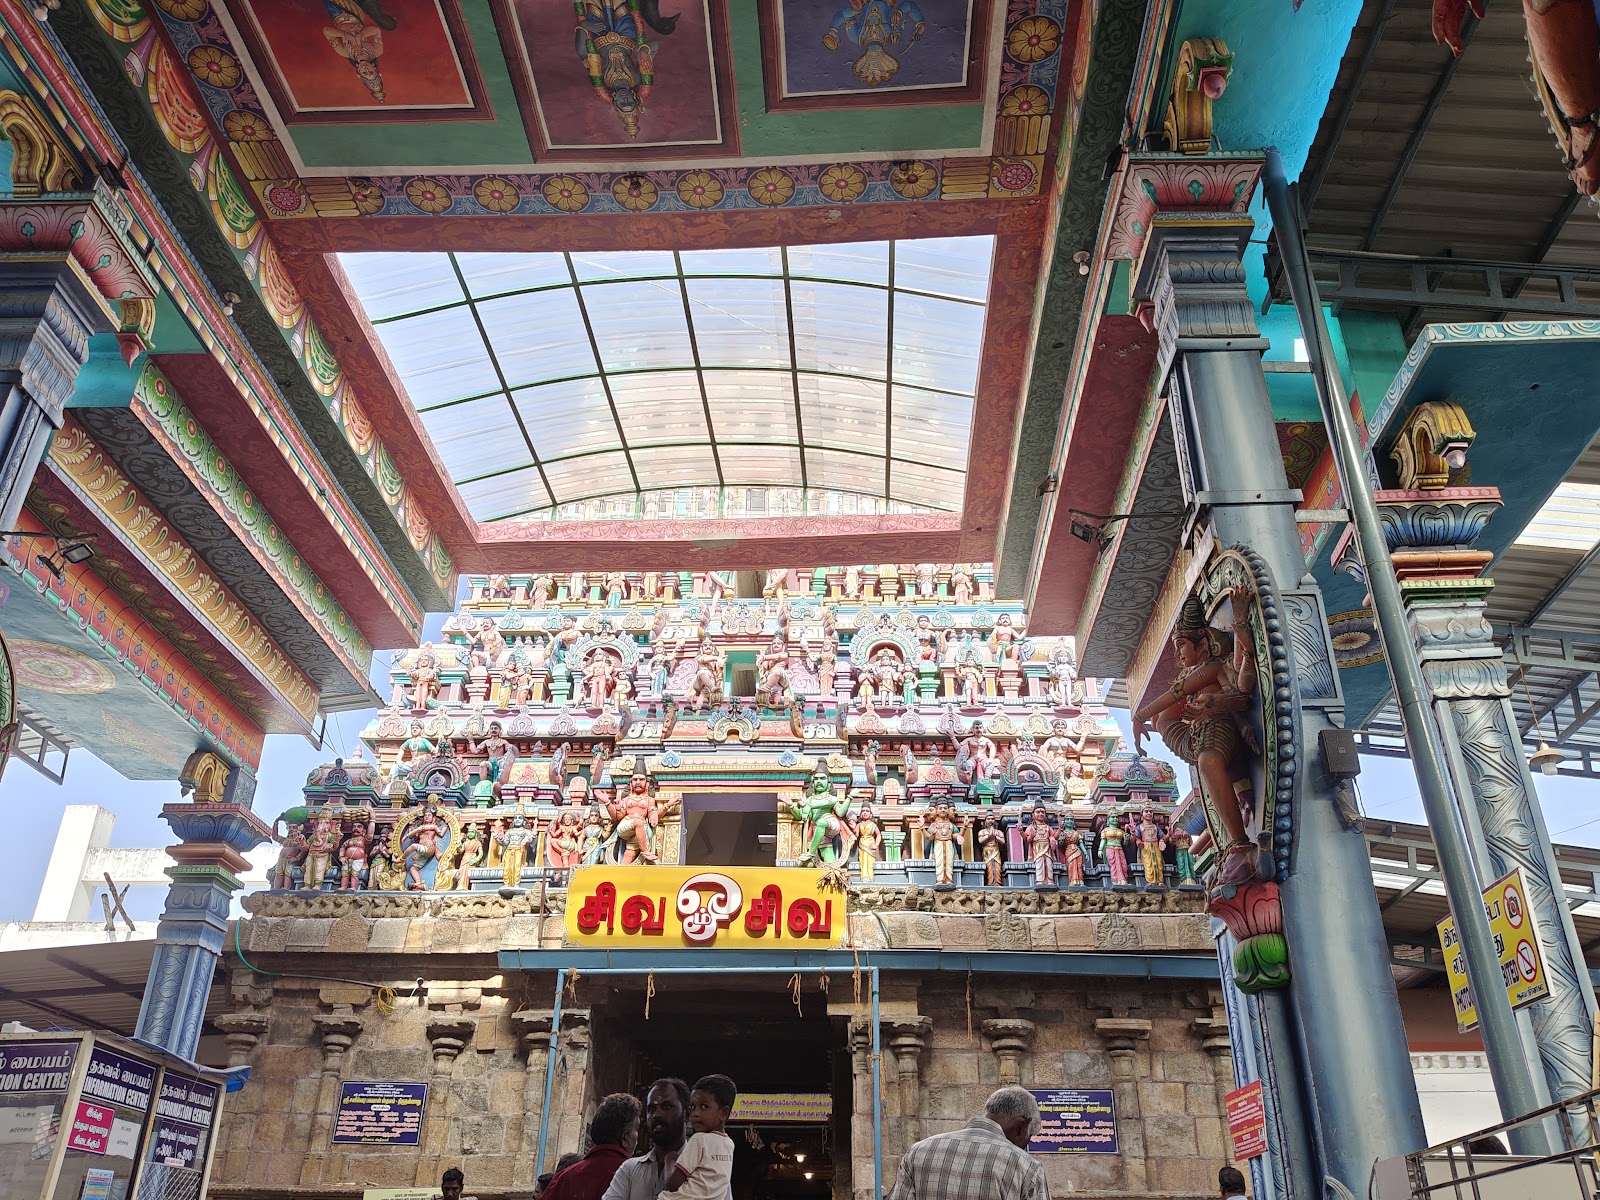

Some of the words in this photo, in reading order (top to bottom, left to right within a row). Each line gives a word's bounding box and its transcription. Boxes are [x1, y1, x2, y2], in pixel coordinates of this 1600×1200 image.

[577, 882, 666, 936] சிவ
[745, 884, 832, 938] சிவ
[10, 1050, 72, 1069] மையம்
[88, 1060, 121, 1080] தகவல்
[23, 1072, 69, 1090] CENTRE
[83, 1076, 127, 1103] INFORMATION
[125, 1088, 149, 1108] CENTRE
[156, 1099, 193, 1121] INFORMATION
[191, 1108, 211, 1125] CENTRE
